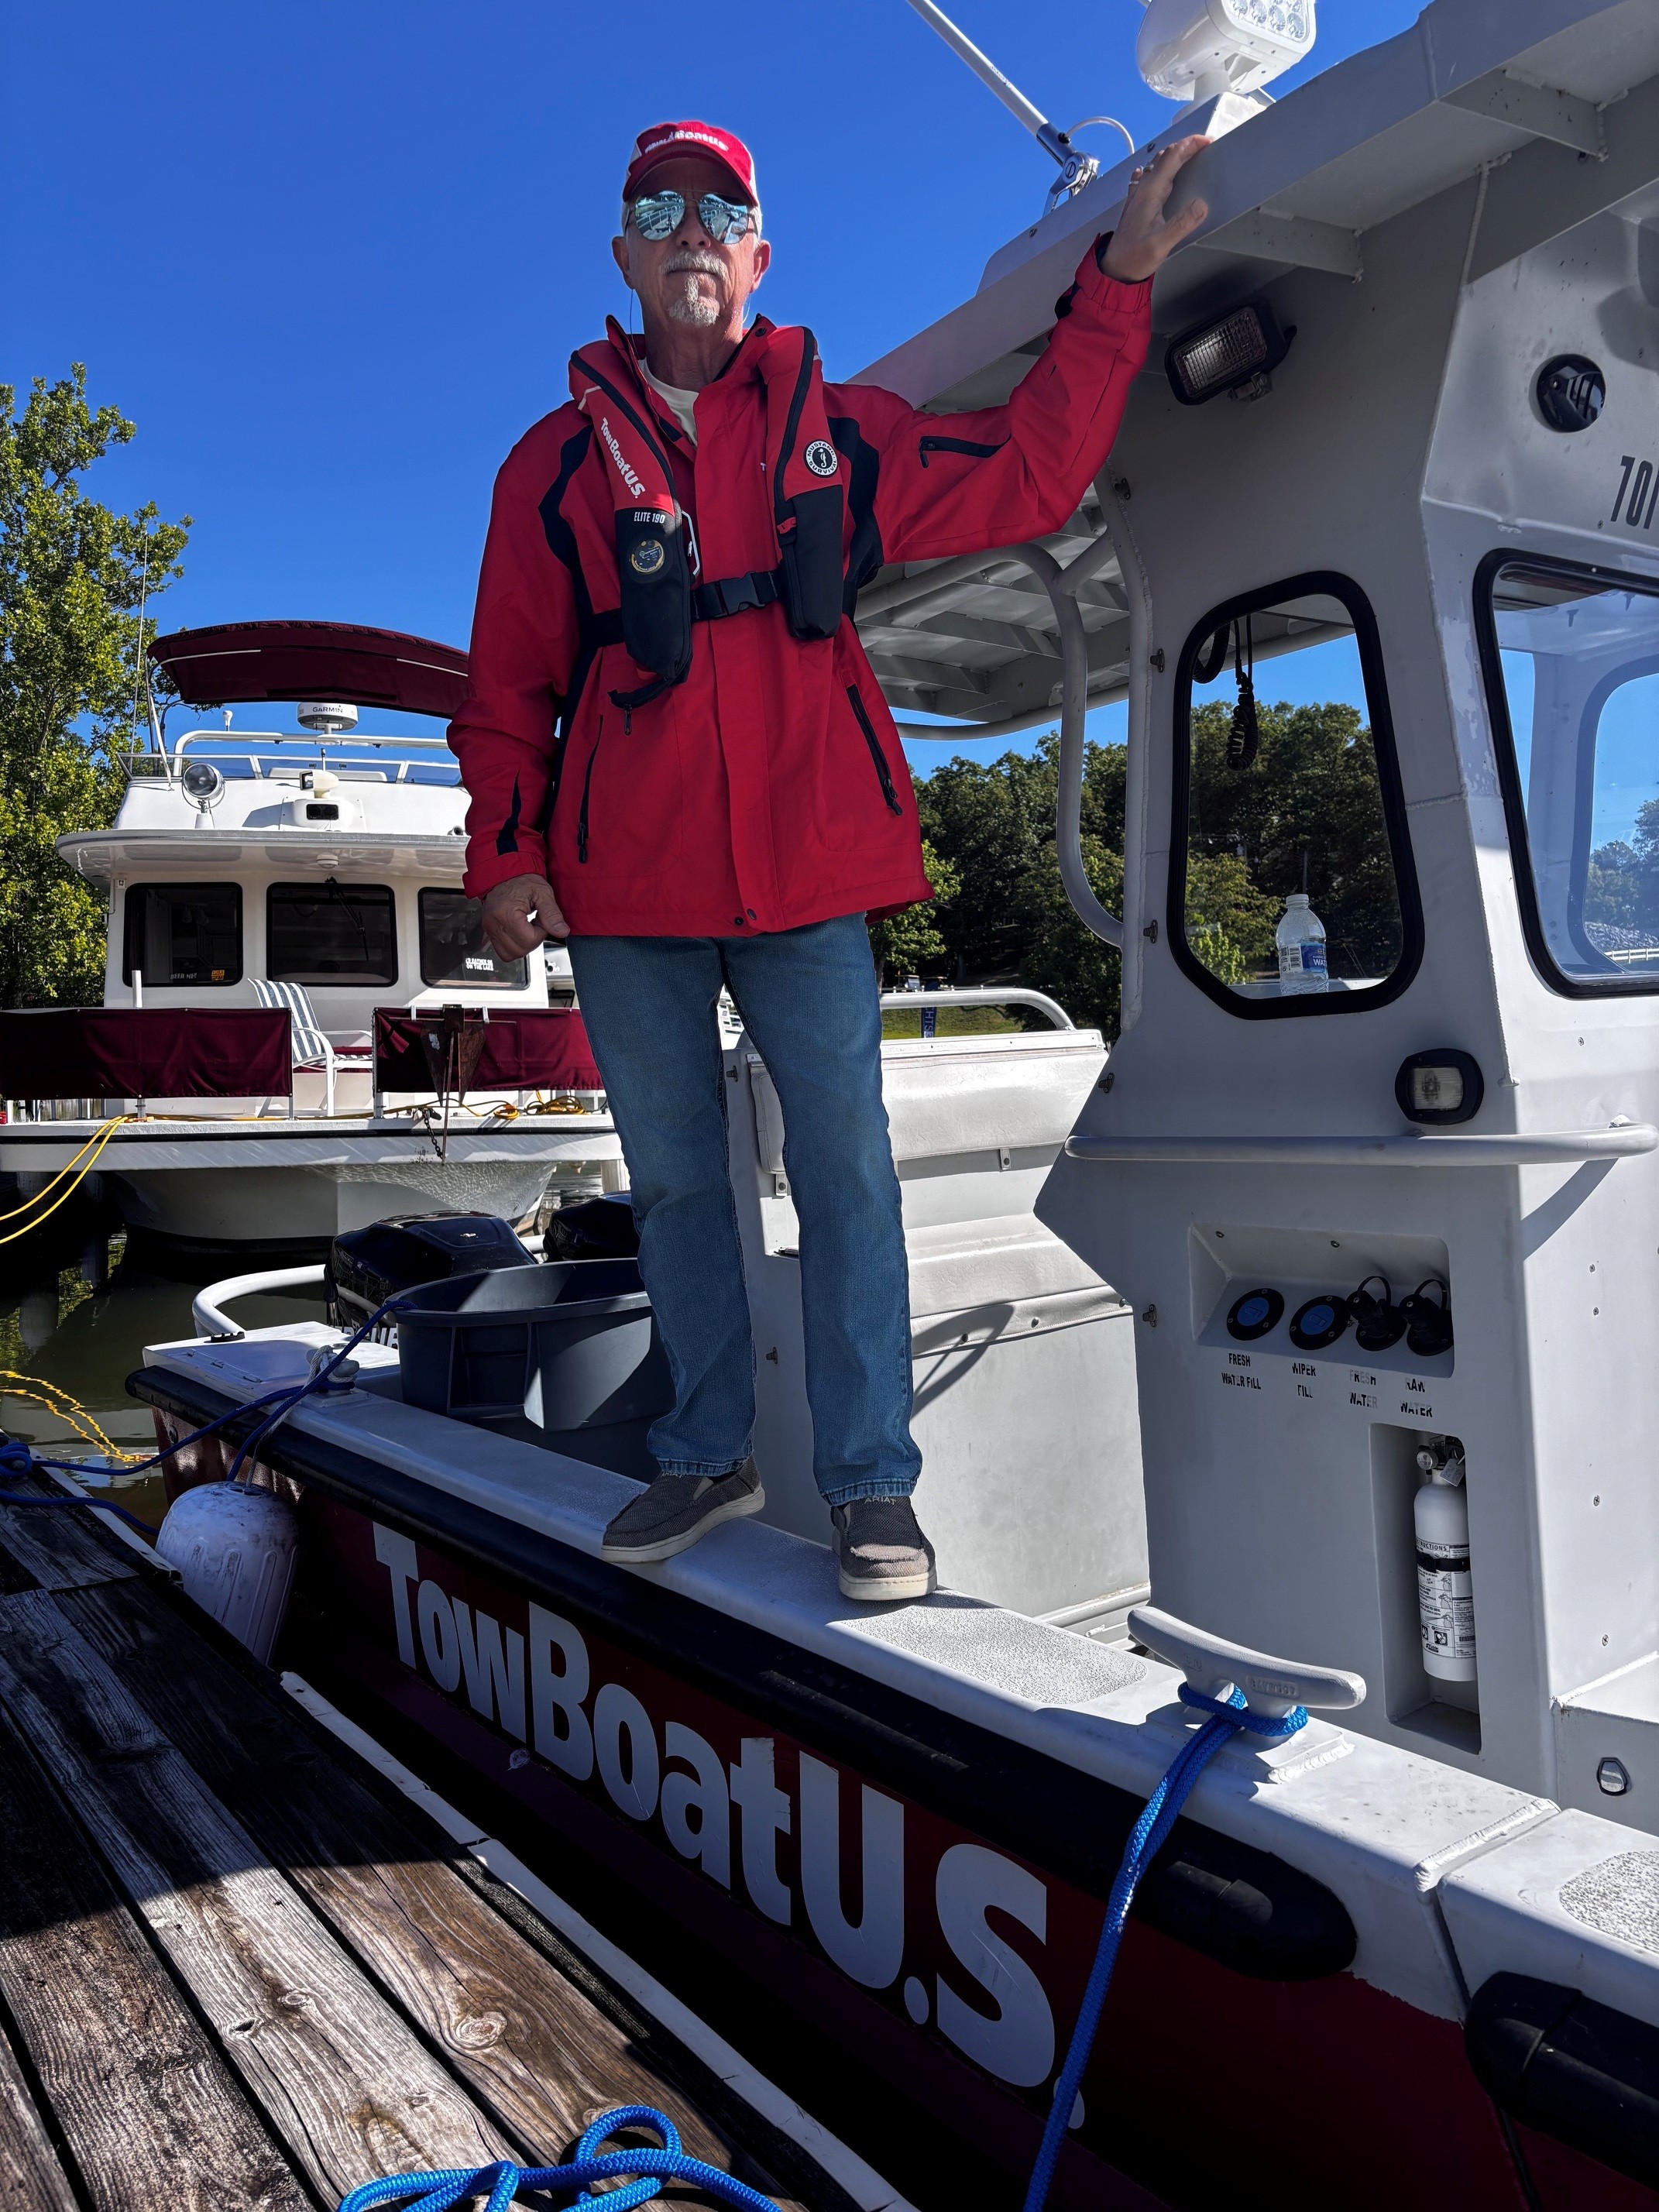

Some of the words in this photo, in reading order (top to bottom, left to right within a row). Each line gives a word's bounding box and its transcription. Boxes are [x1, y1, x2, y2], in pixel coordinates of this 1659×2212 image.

[807, 441, 835, 458] MUSTANG
[809, 459, 837, 474] SURVIVAL
[634, 512, 651, 523] ELITE
[652, 514, 666, 524] 190
[1228, 1352, 1251, 1367] FRESH
[1292, 1362, 1317, 1377] WIPER
[1221, 1372, 1245, 1387] WATER
[1246, 1376, 1262, 1390] FILL
[1297, 1384, 1313, 1398] FILL
[1349, 1392, 1378, 1409] WATER
[1400, 1400, 1433, 1418] WATER
[864, 1496, 897, 1506] ARIAT
